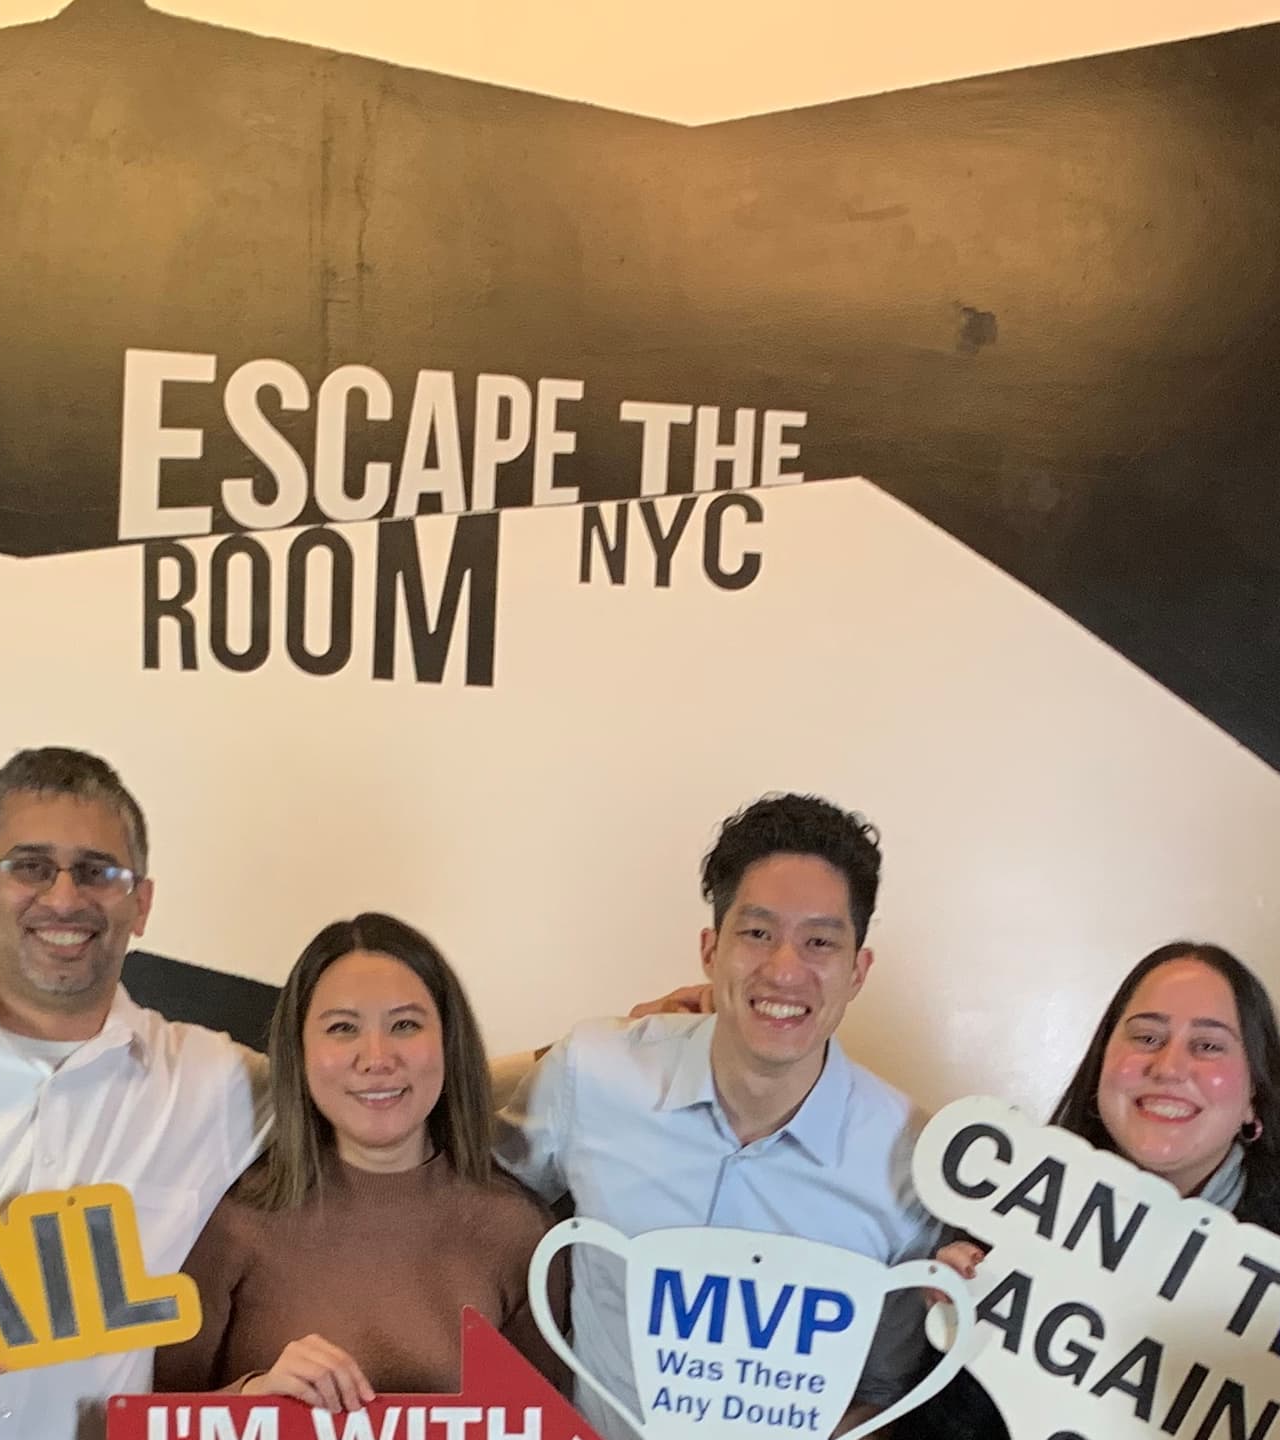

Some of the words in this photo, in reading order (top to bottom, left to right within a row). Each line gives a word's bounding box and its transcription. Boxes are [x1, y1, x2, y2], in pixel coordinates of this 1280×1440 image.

[118, 348, 585, 540] ESCAPE
[621, 401, 808, 498] THE
[142, 511, 501, 689] ROOM
[578, 493, 765, 591] NYC
[941, 1122, 1150, 1273] CAN
[647, 1268, 855, 1355] MVP
[651, 1387, 711, 1422] Any
[721, 1395, 822, 1431] Doubt
[657, 1348, 724, 1381] Was
[735, 1358, 828, 1395] There
